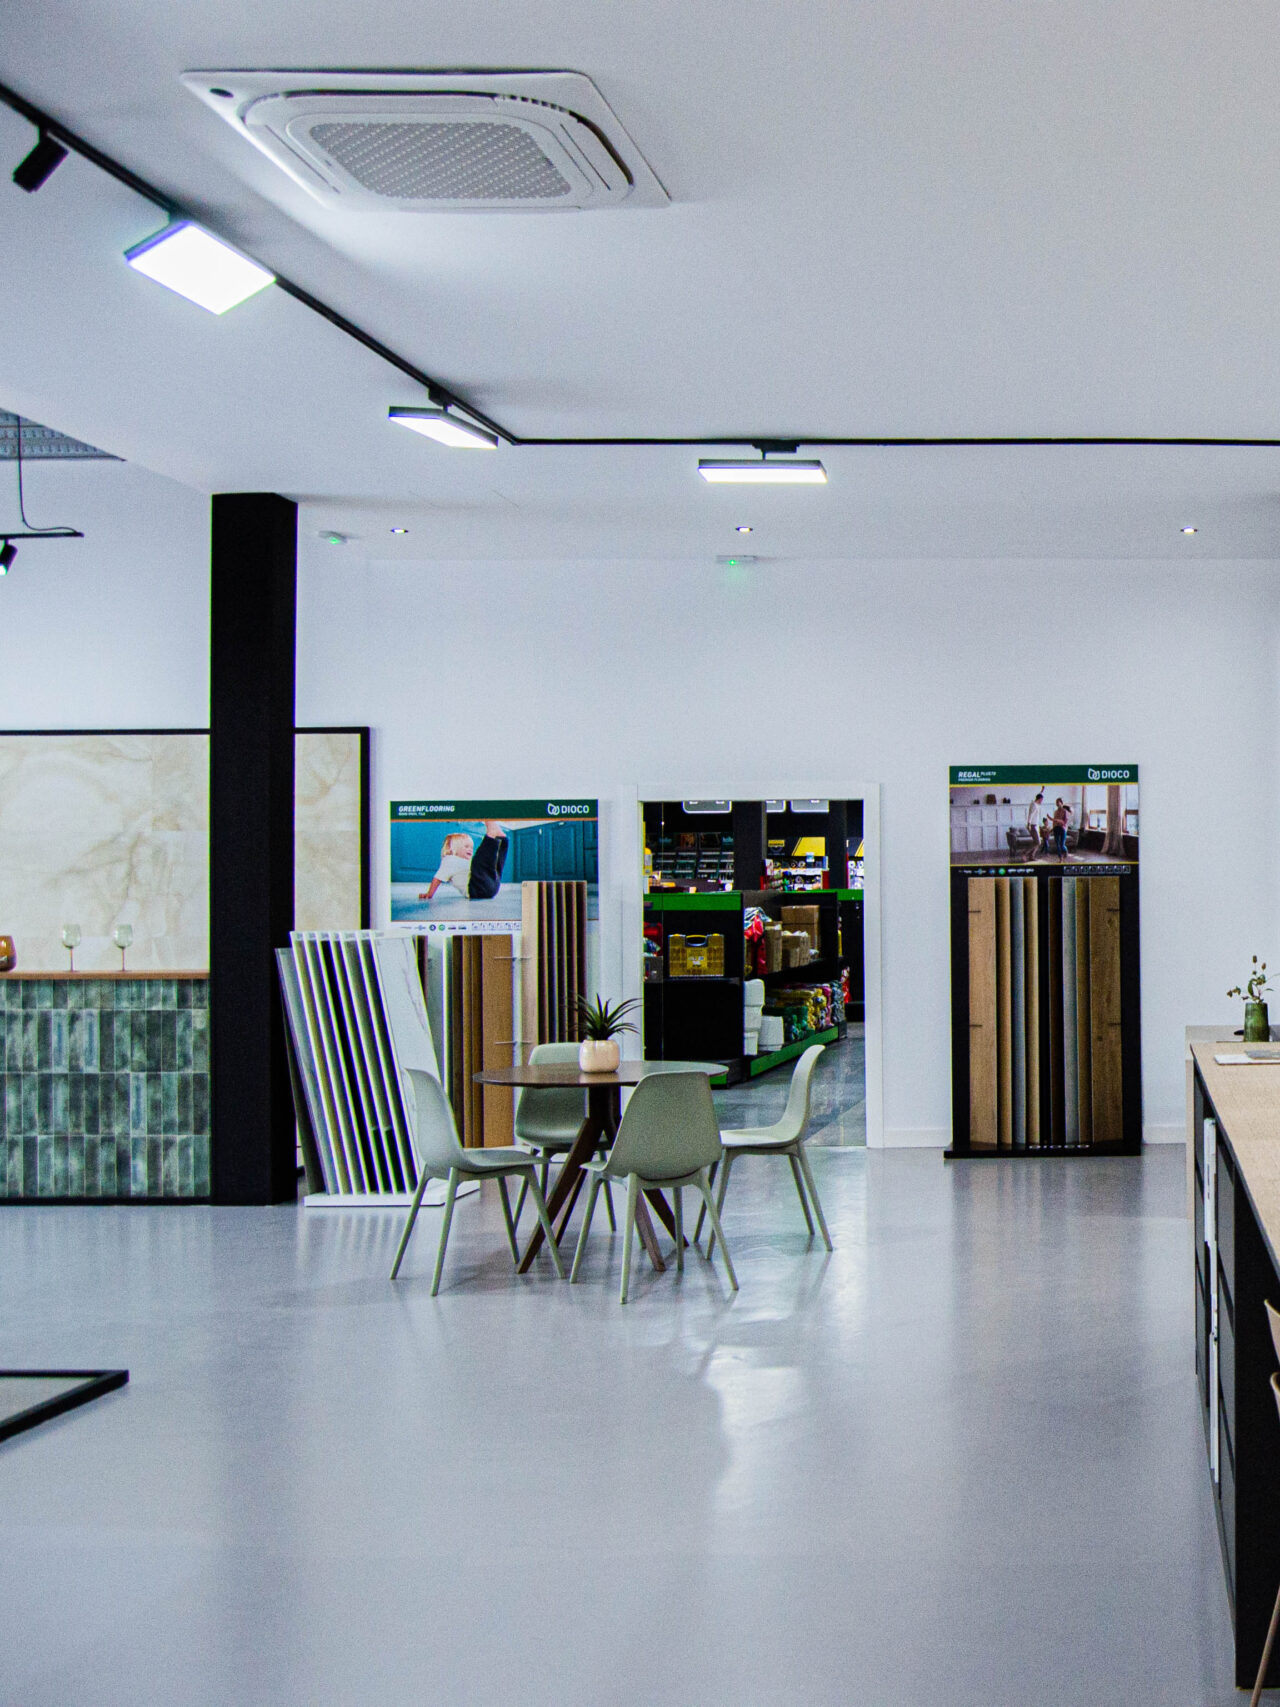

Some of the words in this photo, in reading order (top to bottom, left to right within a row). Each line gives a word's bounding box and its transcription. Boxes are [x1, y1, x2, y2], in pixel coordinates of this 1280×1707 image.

[1101, 769, 1130, 779] DIOCO
[398, 805, 456, 813] GREENFLOORING
[561, 805, 590, 814] DIOCO
